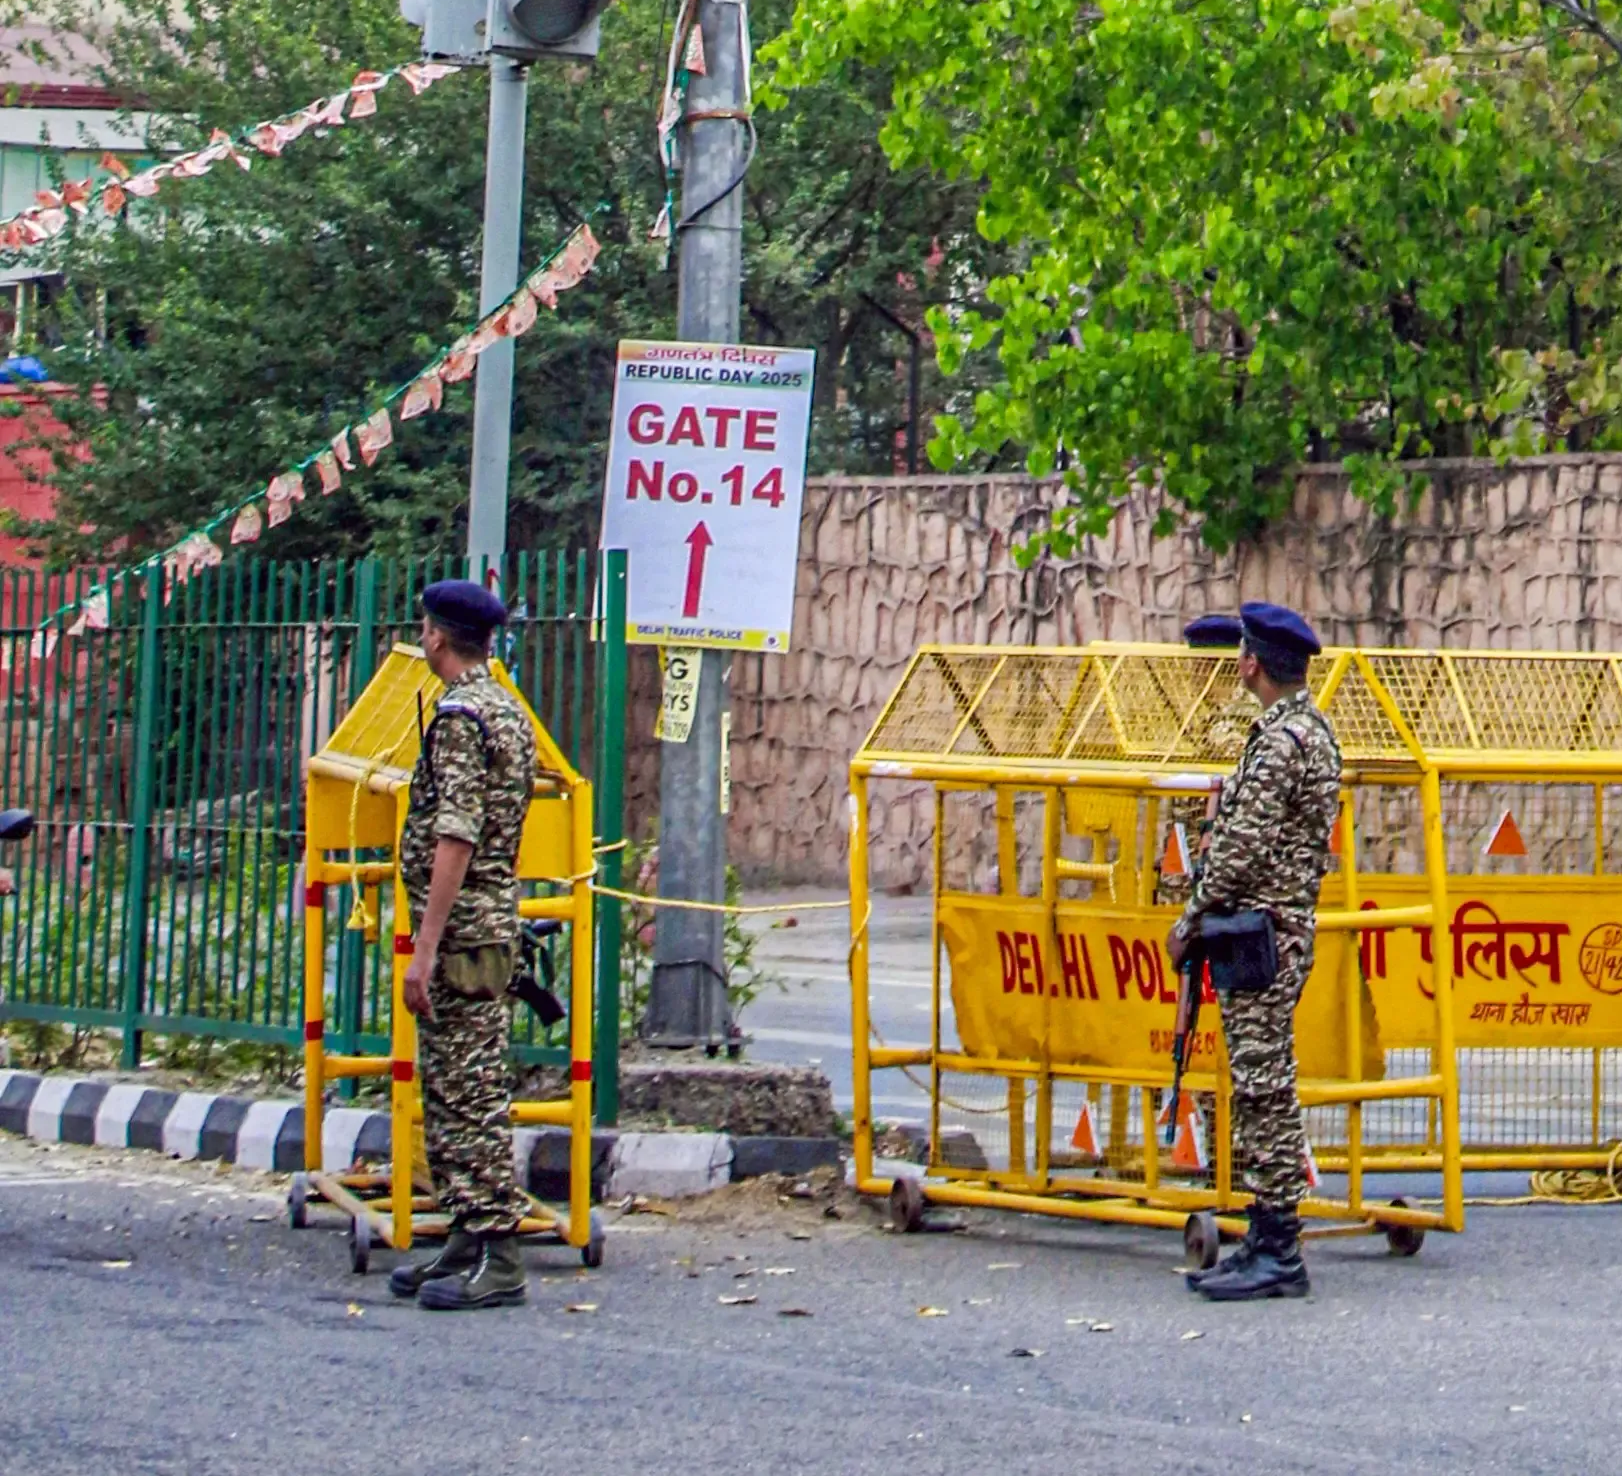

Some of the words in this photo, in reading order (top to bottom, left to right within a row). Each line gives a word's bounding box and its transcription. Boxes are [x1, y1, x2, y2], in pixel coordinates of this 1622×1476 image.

[625, 363, 713, 382] REPUBLIC
[719, 368, 753, 383] DAY
[759, 371, 803, 388] 2025
[627, 402, 779, 453] GATE
[637, 624, 665, 635] DELHI
[668, 625, 705, 638] TRAFFIC
[708, 629, 742, 641] POLICE
